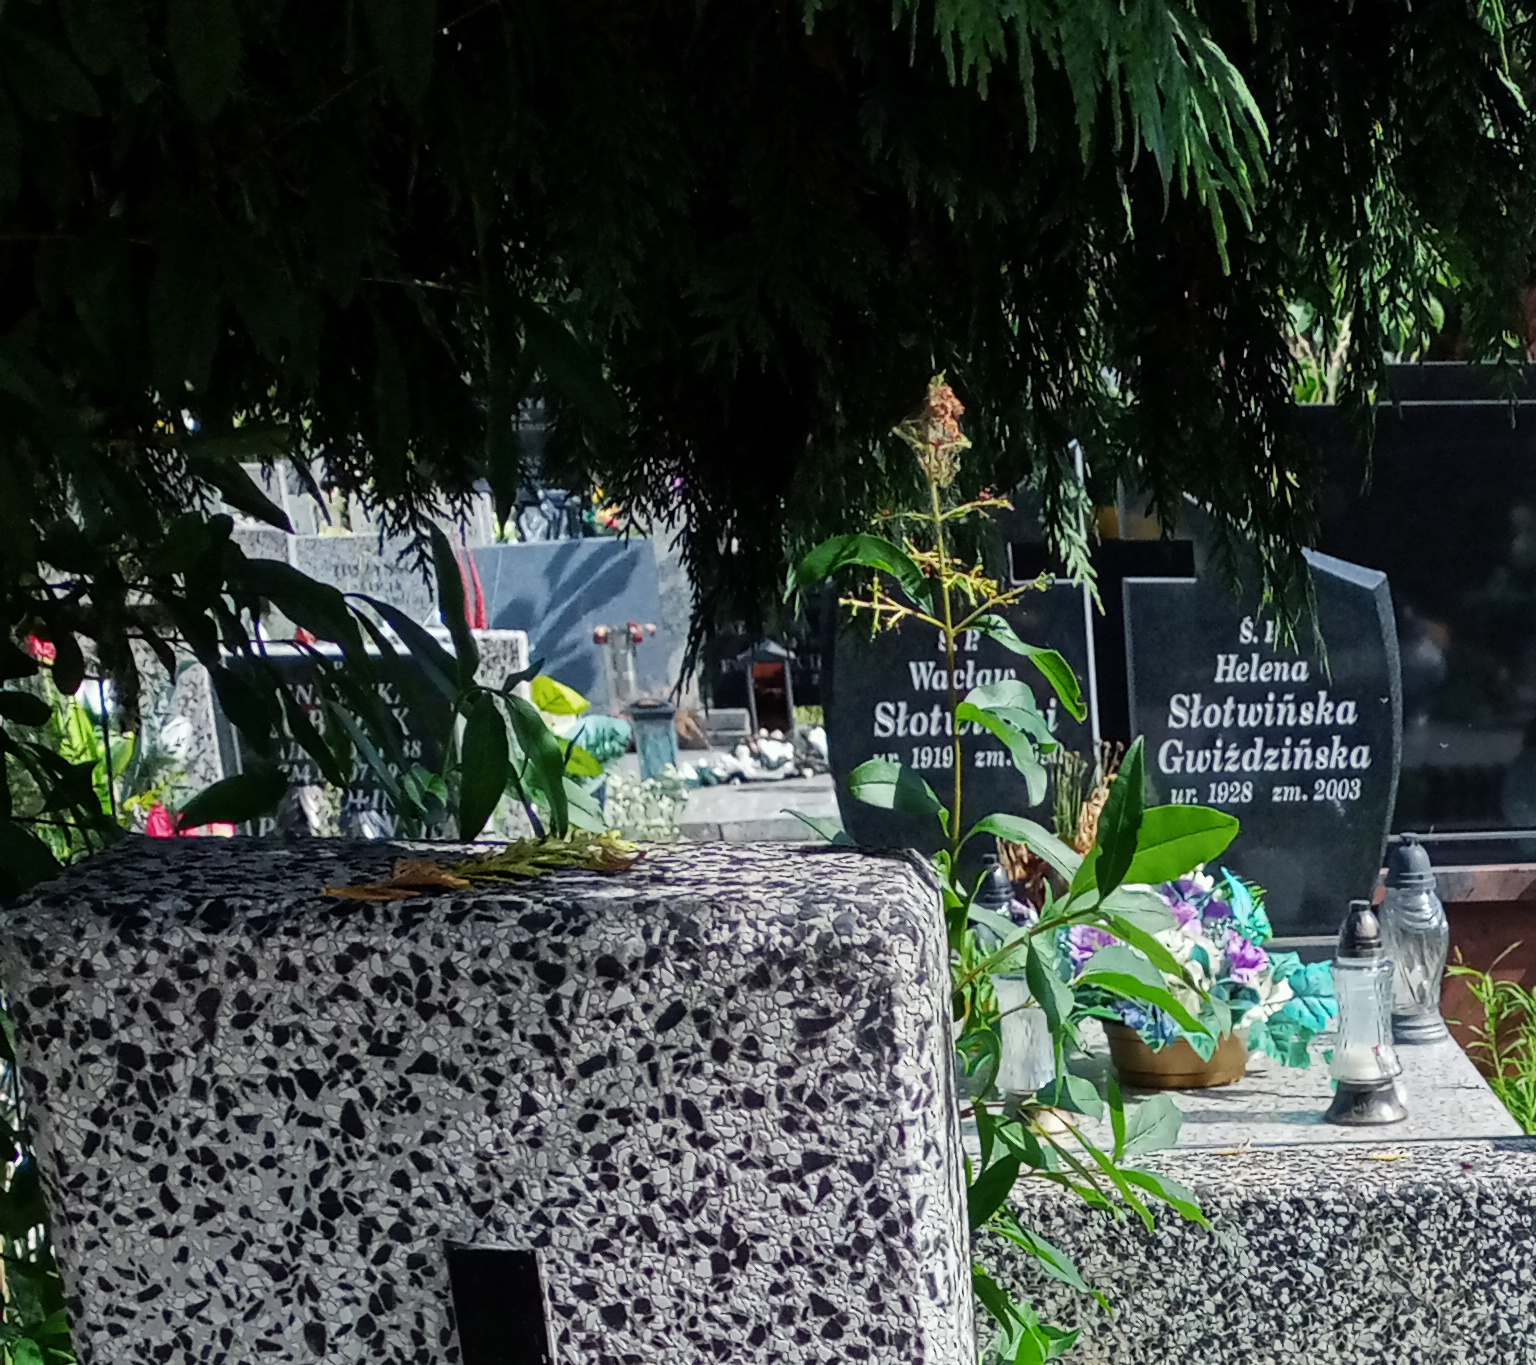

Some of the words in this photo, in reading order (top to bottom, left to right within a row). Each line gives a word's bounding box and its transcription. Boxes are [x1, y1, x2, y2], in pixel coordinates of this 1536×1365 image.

[1214, 653, 1310, 684] Helena
[911, 745, 955, 769] 1919
[974, 750, 1013, 768] zm.
[1170, 786, 1199, 805] ur.
[1207, 781, 1254, 805] 1928
[1272, 784, 1309, 802] zm.
[1313, 777, 1362, 801] 2003
